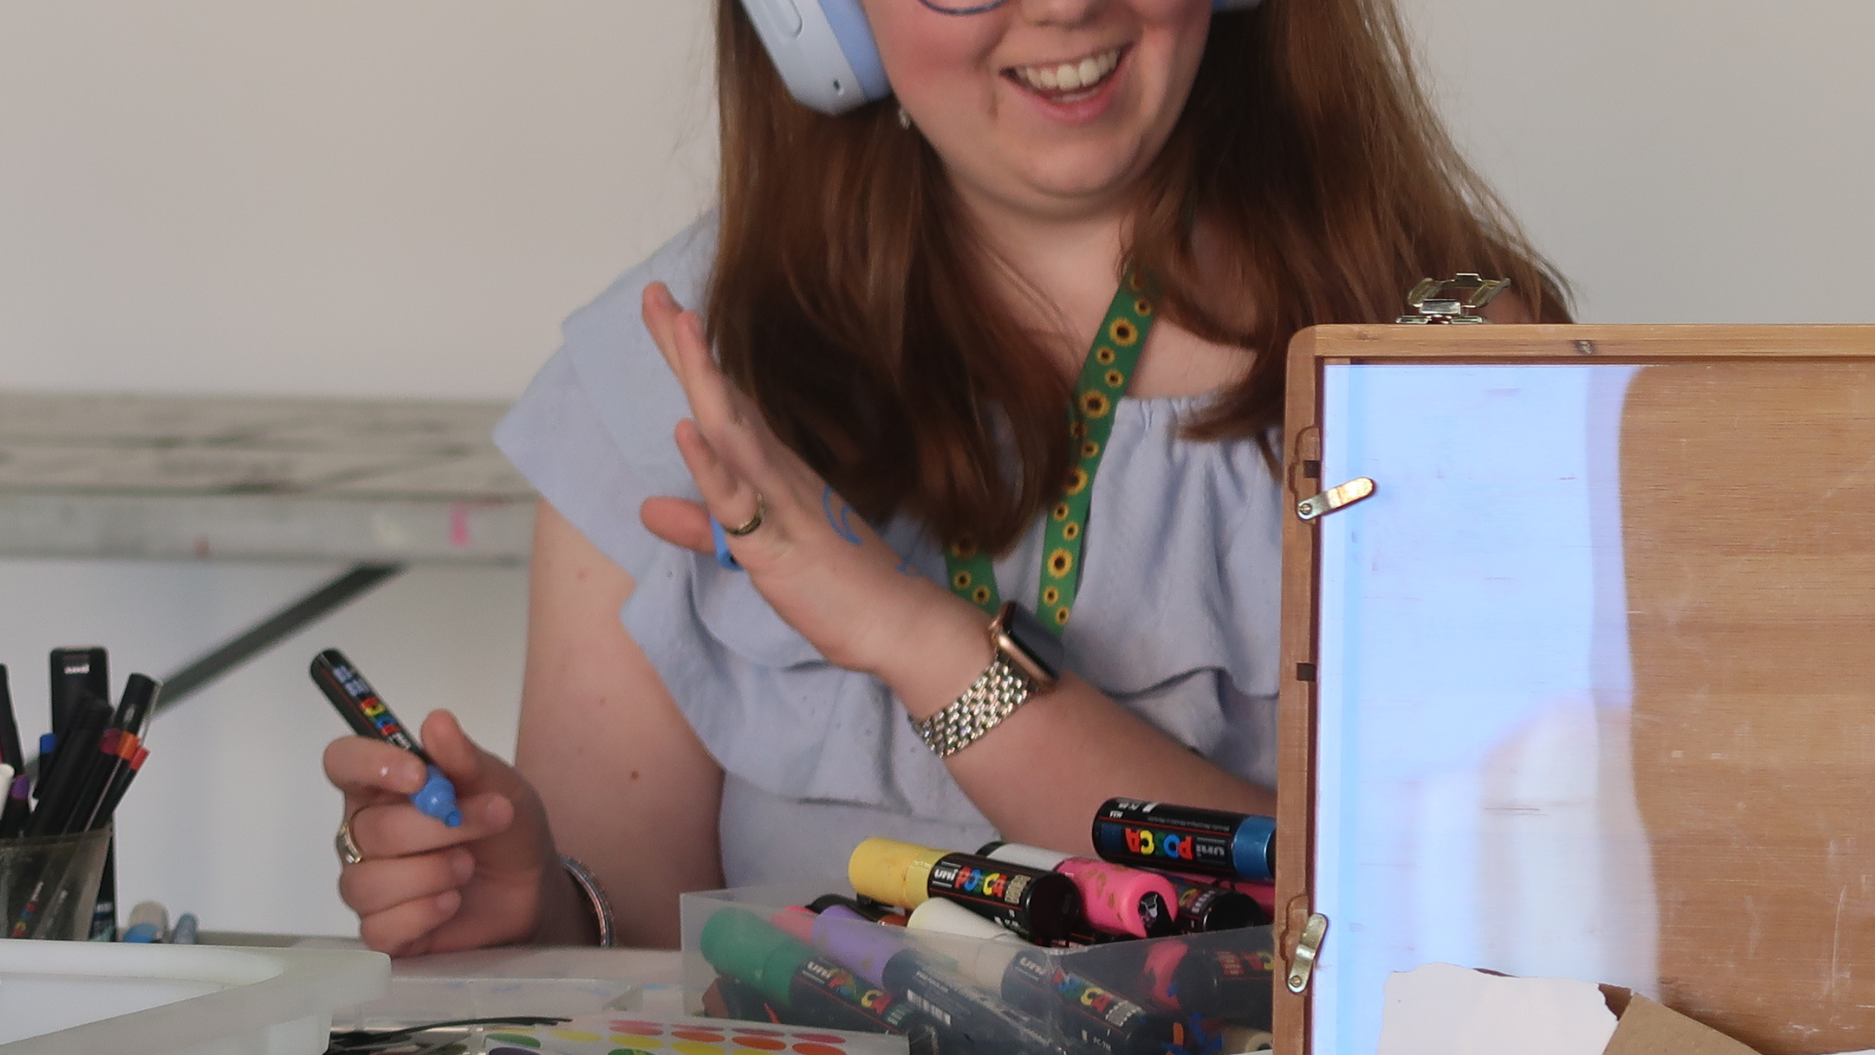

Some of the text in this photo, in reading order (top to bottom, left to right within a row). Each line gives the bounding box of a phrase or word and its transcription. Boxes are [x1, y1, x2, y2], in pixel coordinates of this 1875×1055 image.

[1124, 827, 1194, 860] POSCA
[933, 868, 959, 882] uni
[954, 865, 1009, 899] POSCA
